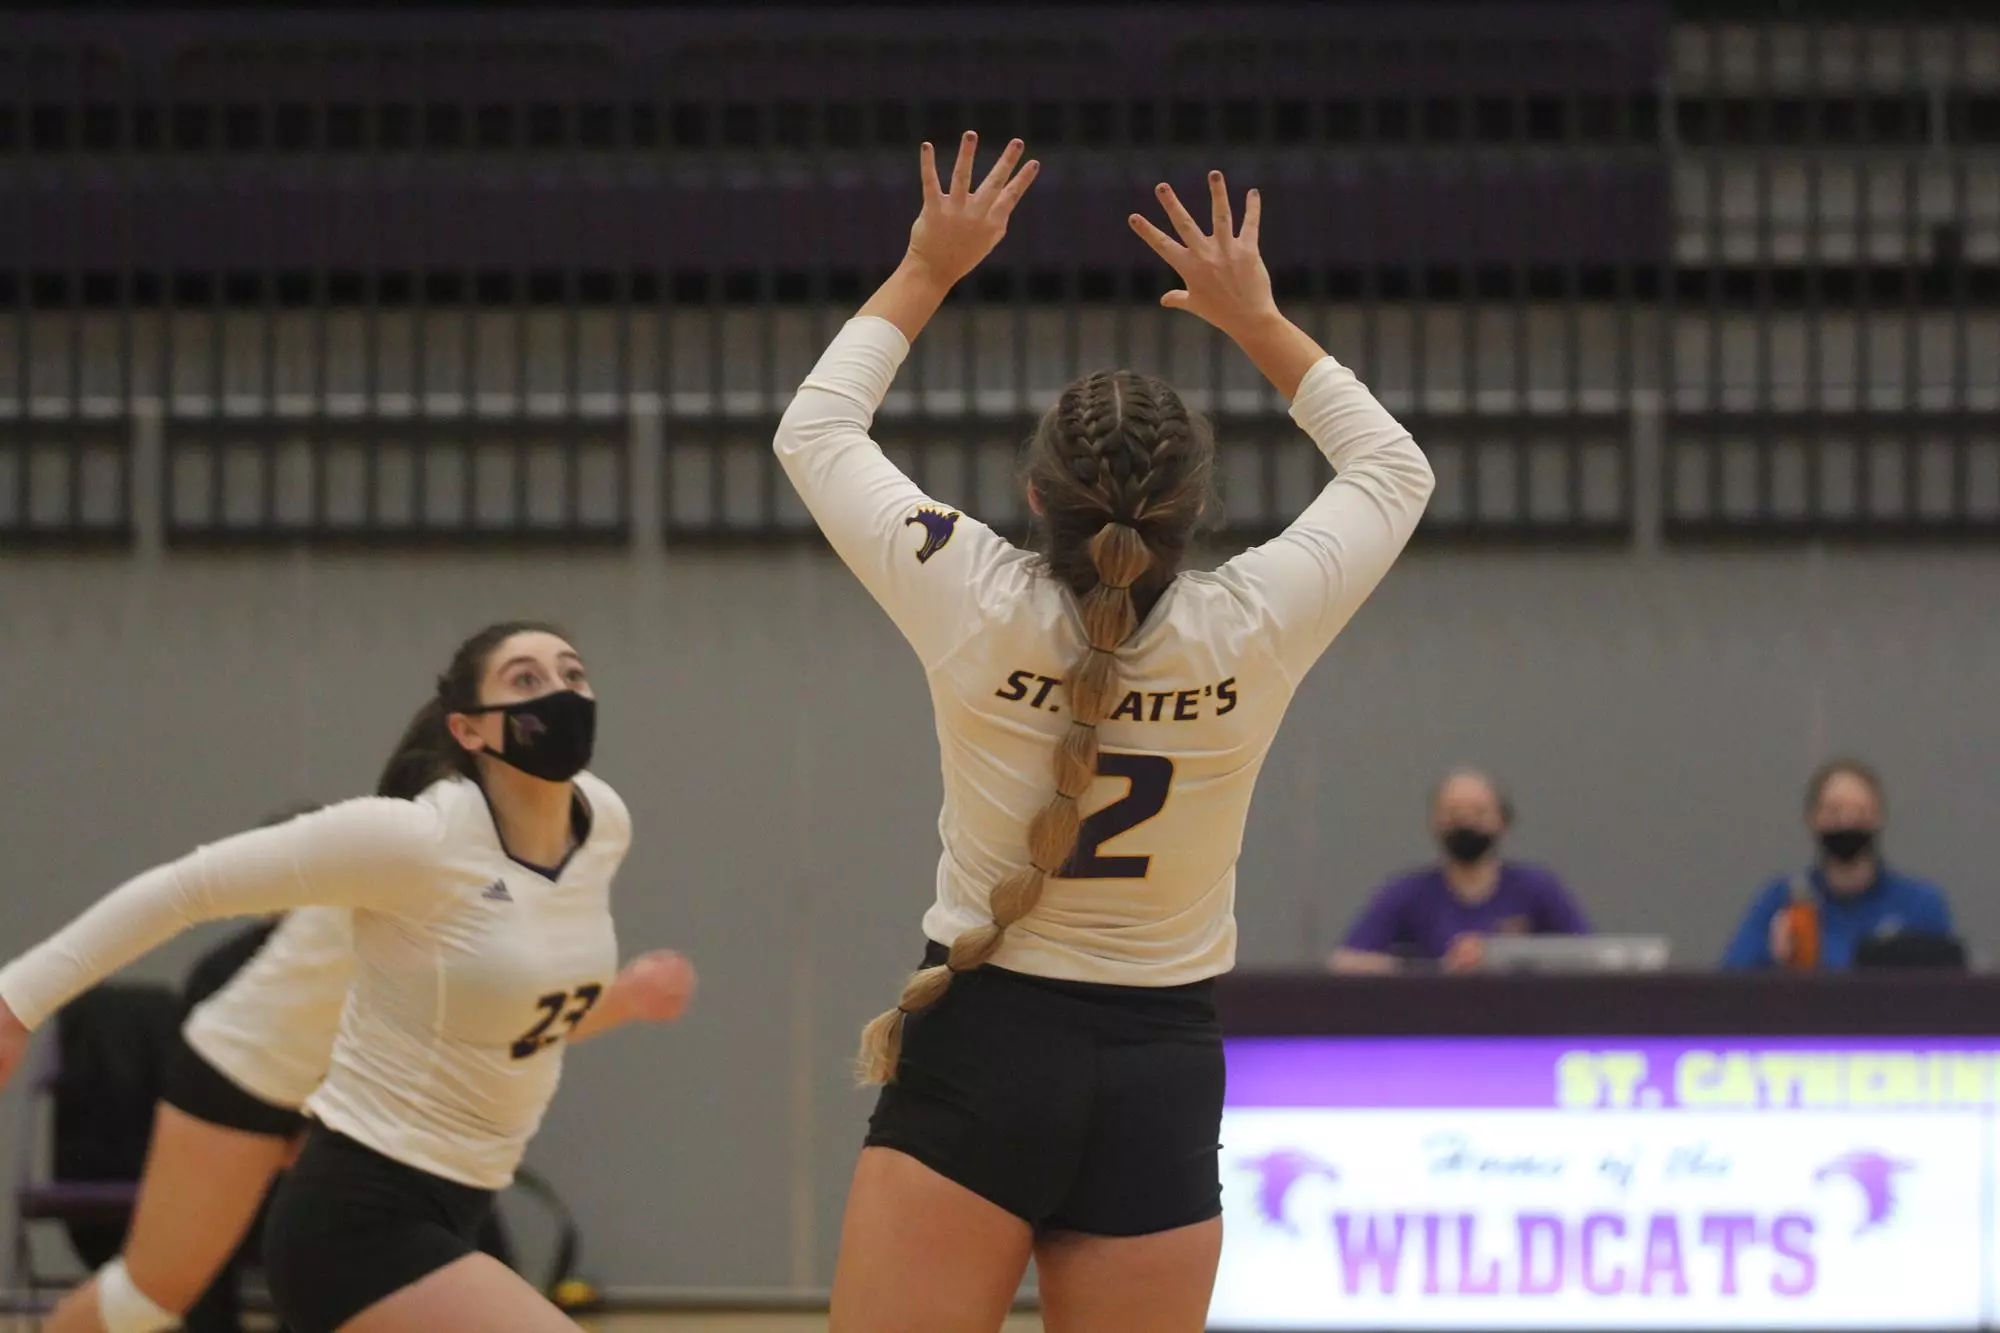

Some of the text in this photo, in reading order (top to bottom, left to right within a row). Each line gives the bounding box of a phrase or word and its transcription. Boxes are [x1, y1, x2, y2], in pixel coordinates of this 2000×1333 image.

[994, 669, 1238, 722] ST. ATE'S
[1054, 751, 1174, 878] 2
[1556, 1050, 2000, 1107] ST. CATHERIN
[1333, 1212, 1818, 1297] WILDCATS
